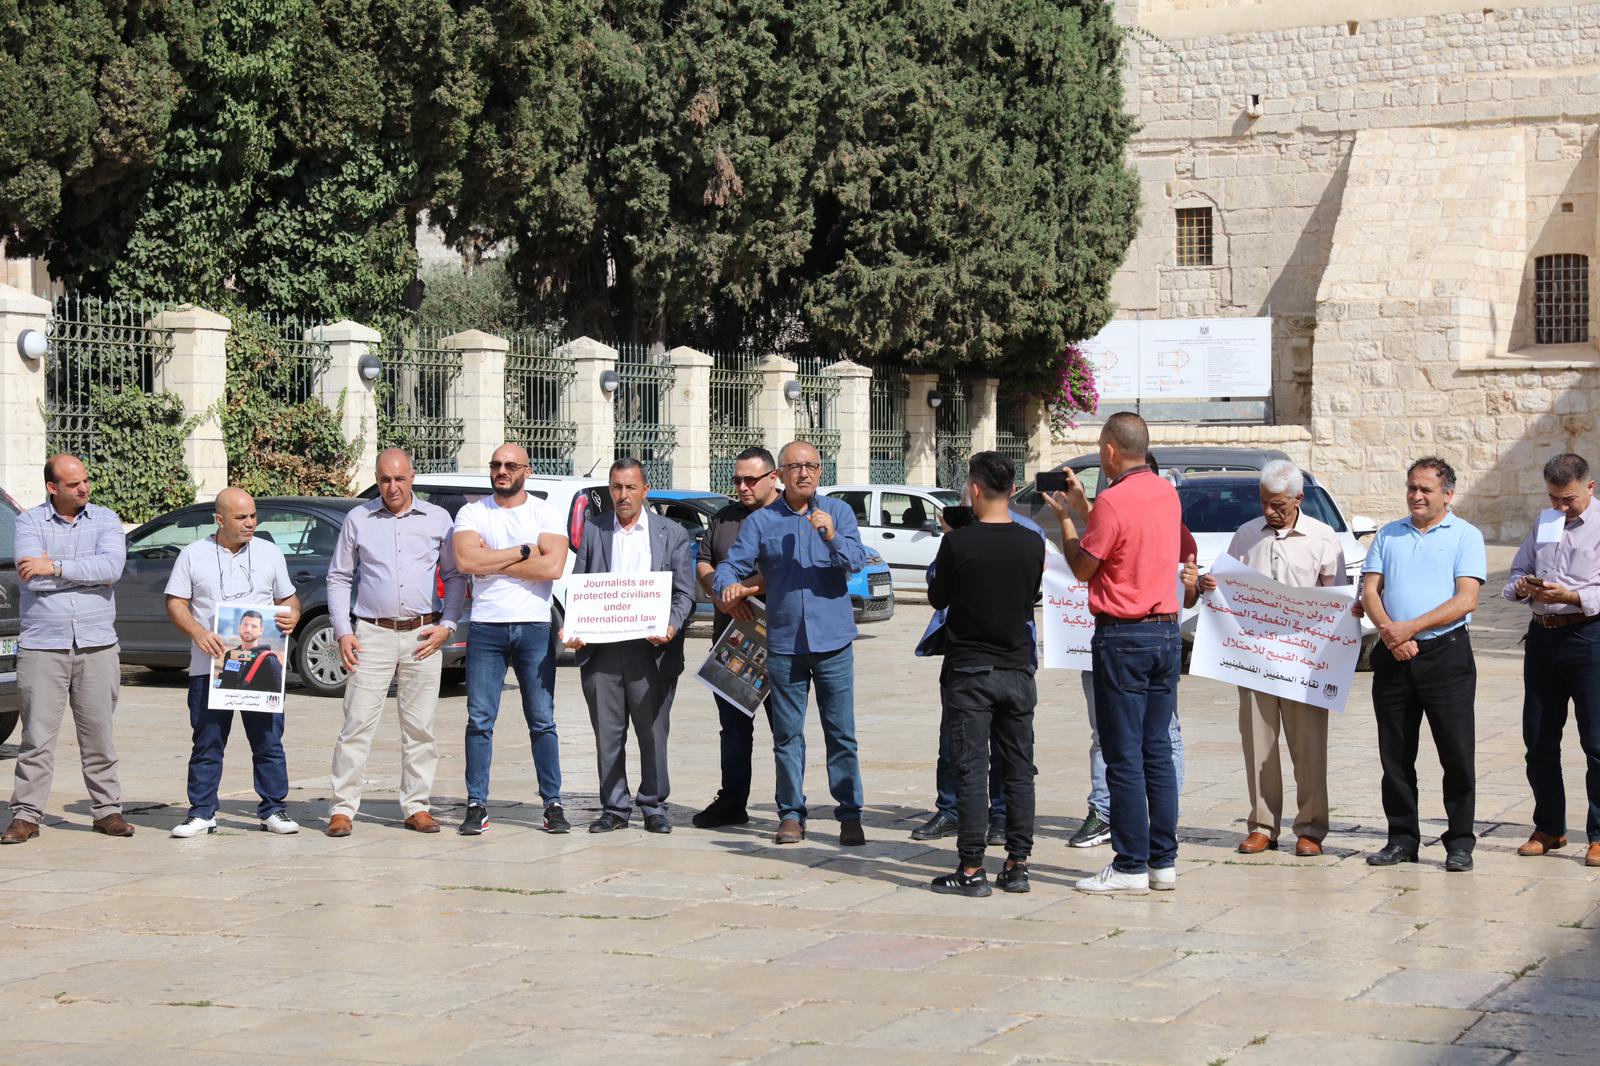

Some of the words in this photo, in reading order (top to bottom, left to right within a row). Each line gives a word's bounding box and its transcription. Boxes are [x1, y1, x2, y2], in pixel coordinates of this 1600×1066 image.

[584, 578, 636, 588] Journalists
[639, 579, 655, 587] are
[573, 590, 618, 602] protected
[620, 590, 661, 599] civilians
[1048, 595, 1085, 610] برعاية
[1232, 592, 1282, 609] الصحفيين
[604, 603, 631, 612] under
[1206, 599, 1250, 618] الصحفية
[577, 614, 638, 624] international
[640, 614, 657, 622] law
[1062, 613, 1095, 628] ريكية
[1251, 610, 1291, 627] التغطية
[1292, 618, 1303, 632] في
[1323, 615, 1335, 624] لم
[1238, 626, 1254, 637] عن
[1222, 637, 1265, 655] للاحتلال
[1279, 635, 1317, 653] والكشف
[1342, 636, 1357, 646] من
[1066, 645, 1092, 655] سطينيين
[1266, 649, 1298, 663] القبيح
[1219, 657, 1261, 674] الفلسطينيين
[1300, 657, 1329, 671] الوجه
[1263, 669, 1297, 683] الصحفيين
[1300, 676, 1320, 689] نقابة
